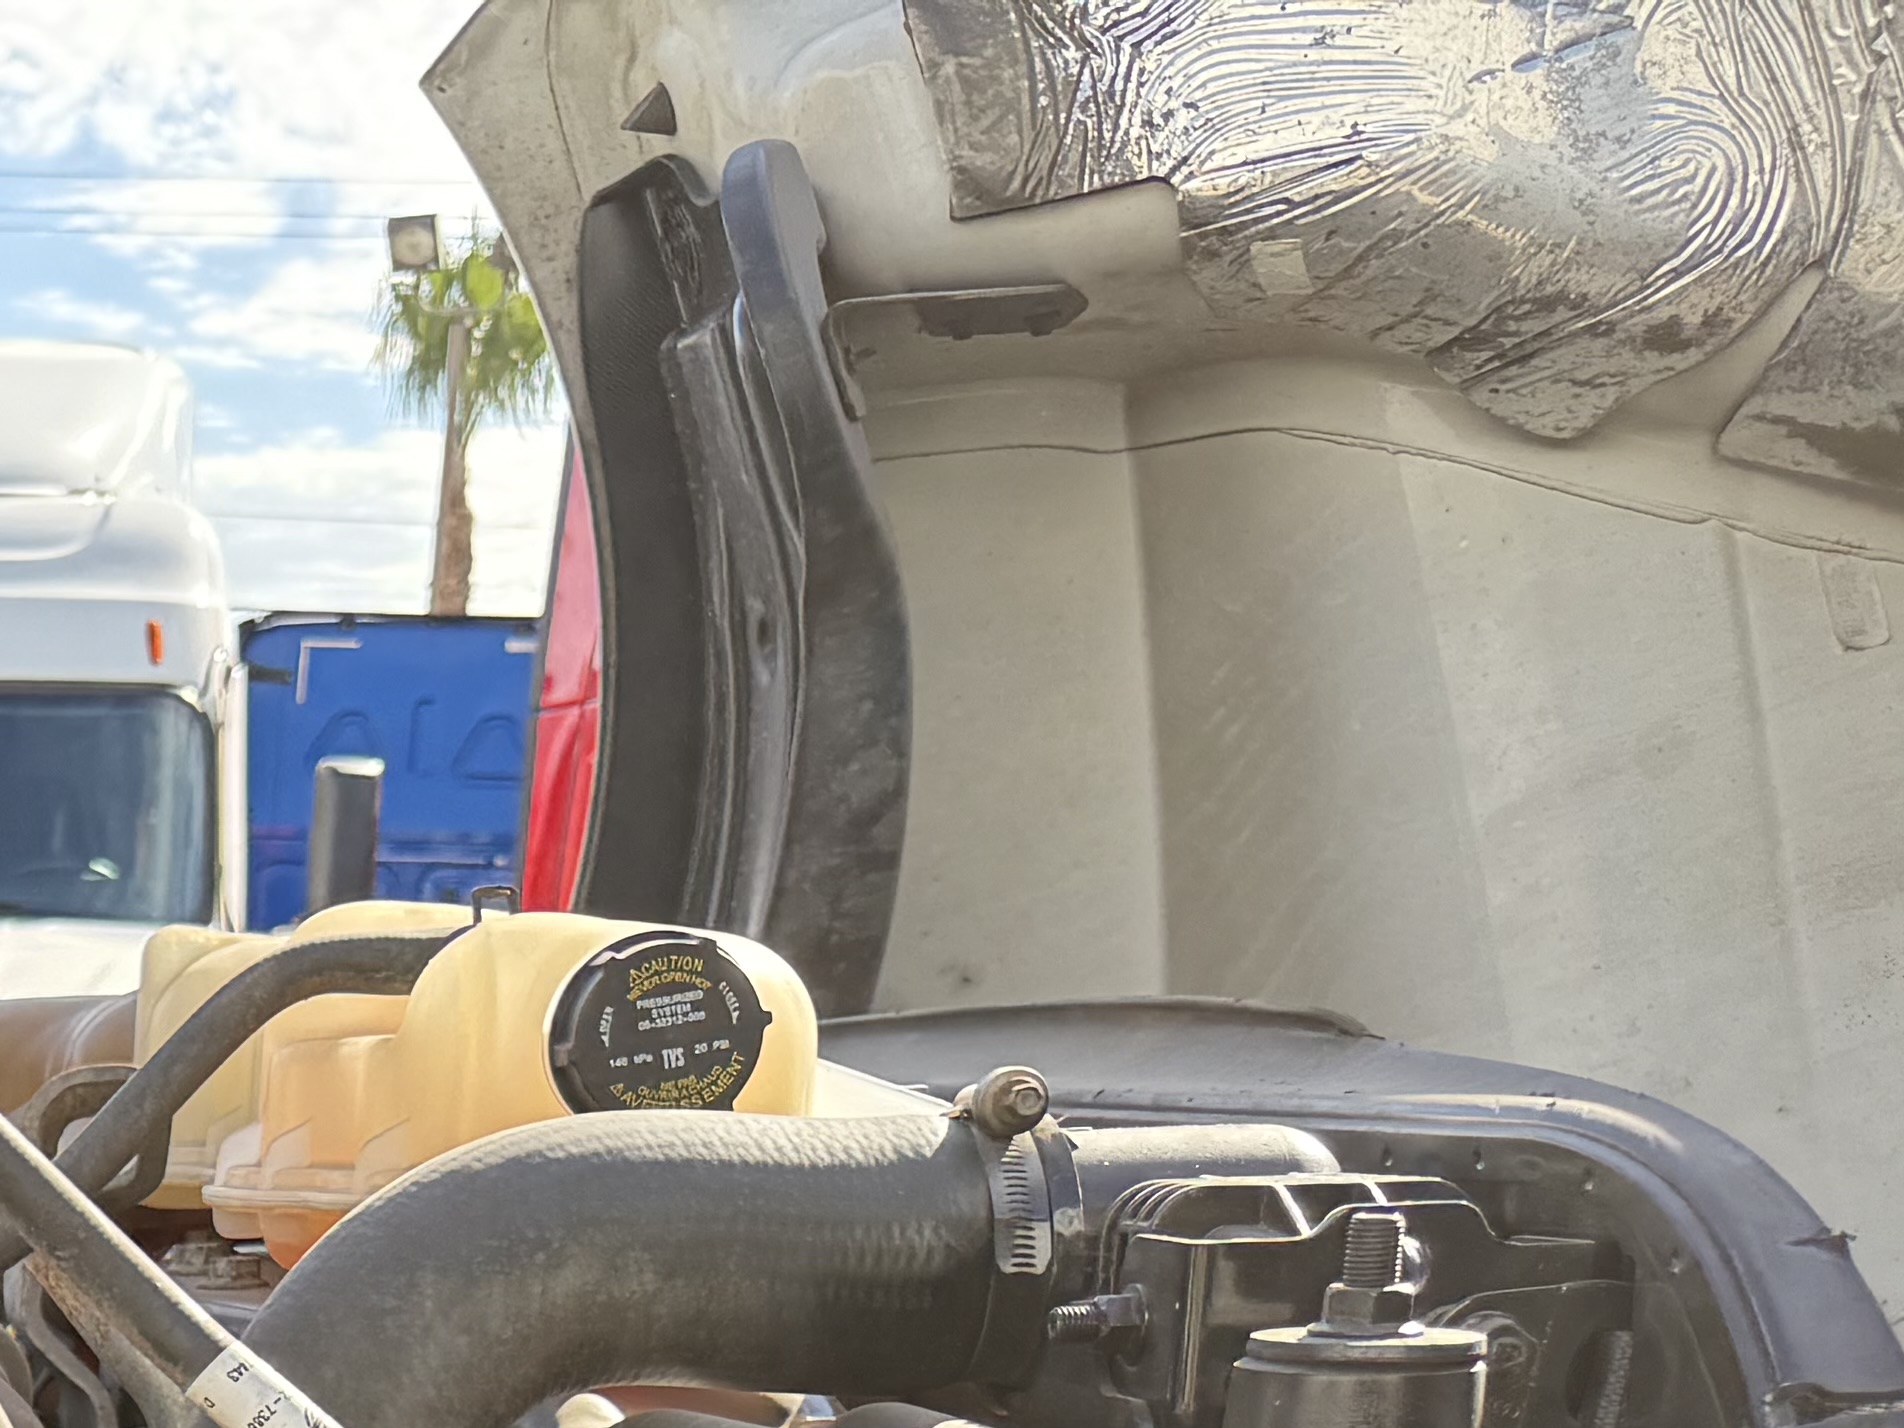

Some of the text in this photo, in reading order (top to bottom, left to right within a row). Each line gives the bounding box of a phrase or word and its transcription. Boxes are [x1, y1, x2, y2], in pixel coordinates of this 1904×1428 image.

[641, 955, 704, 977] CAUTION
[661, 1047, 685, 1070] TVS
[694, 1042, 708, 1055] 20
